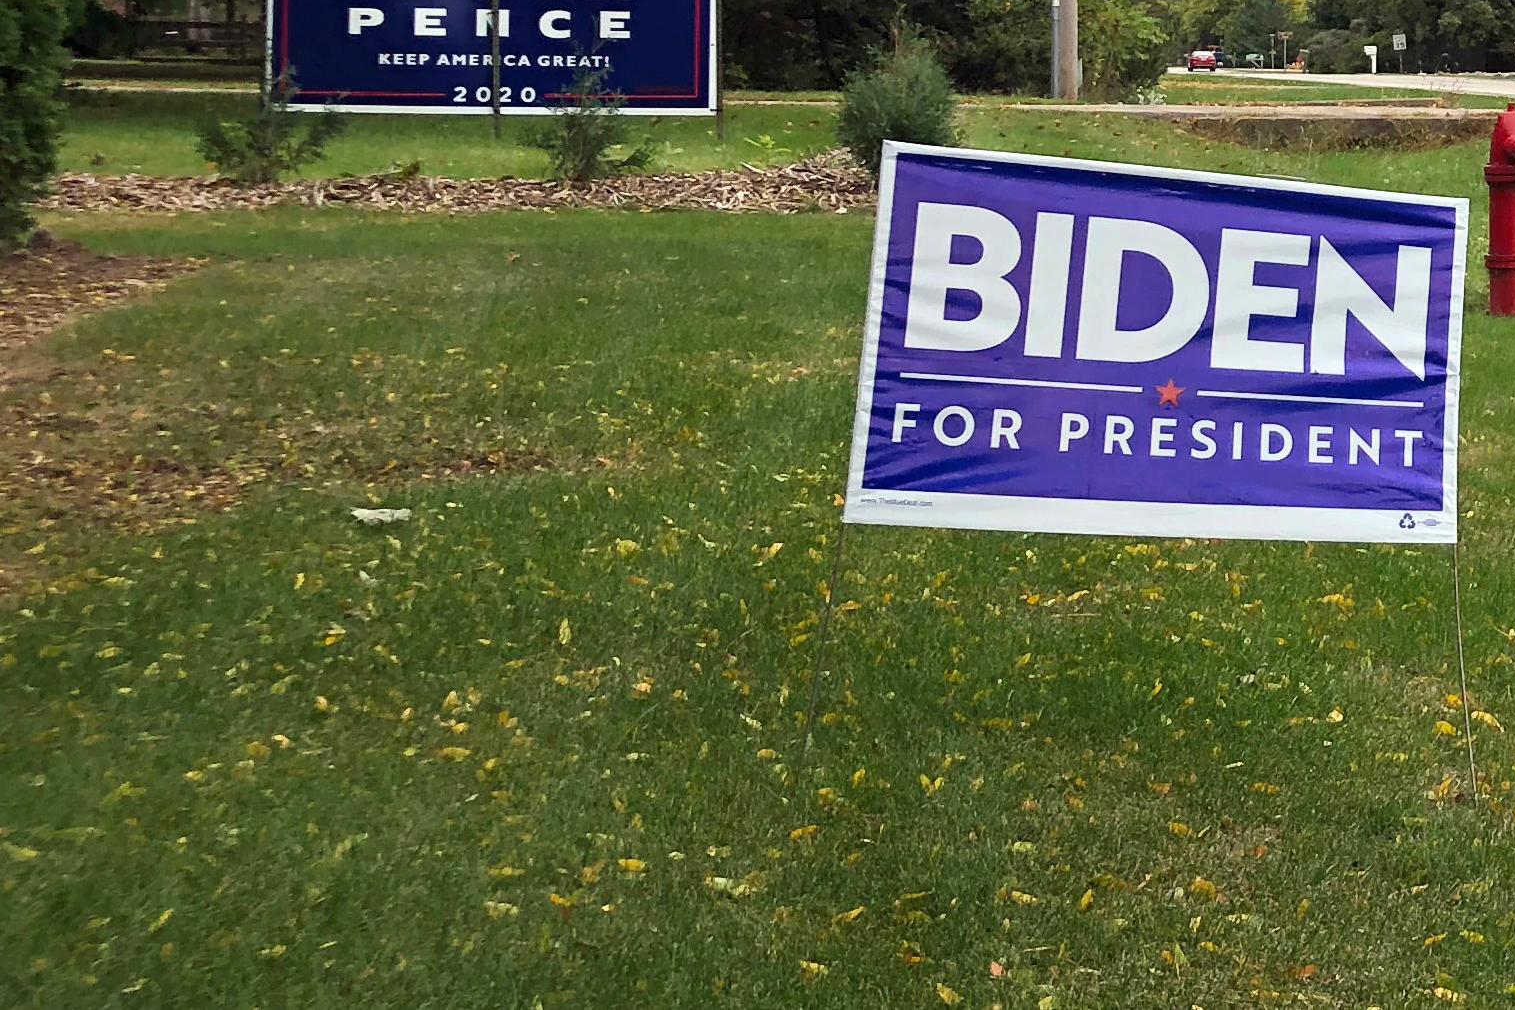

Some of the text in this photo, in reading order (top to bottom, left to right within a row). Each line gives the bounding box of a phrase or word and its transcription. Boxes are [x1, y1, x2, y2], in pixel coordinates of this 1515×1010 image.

[347, 7, 631, 39] PENCE
[377, 53, 610, 68] KEEP AMERCA GREAT!
[452, 86, 536, 103] 2020
[903, 201, 1433, 382] BIDEN
[891, 402, 1424, 467] FOR PRESIDENT
